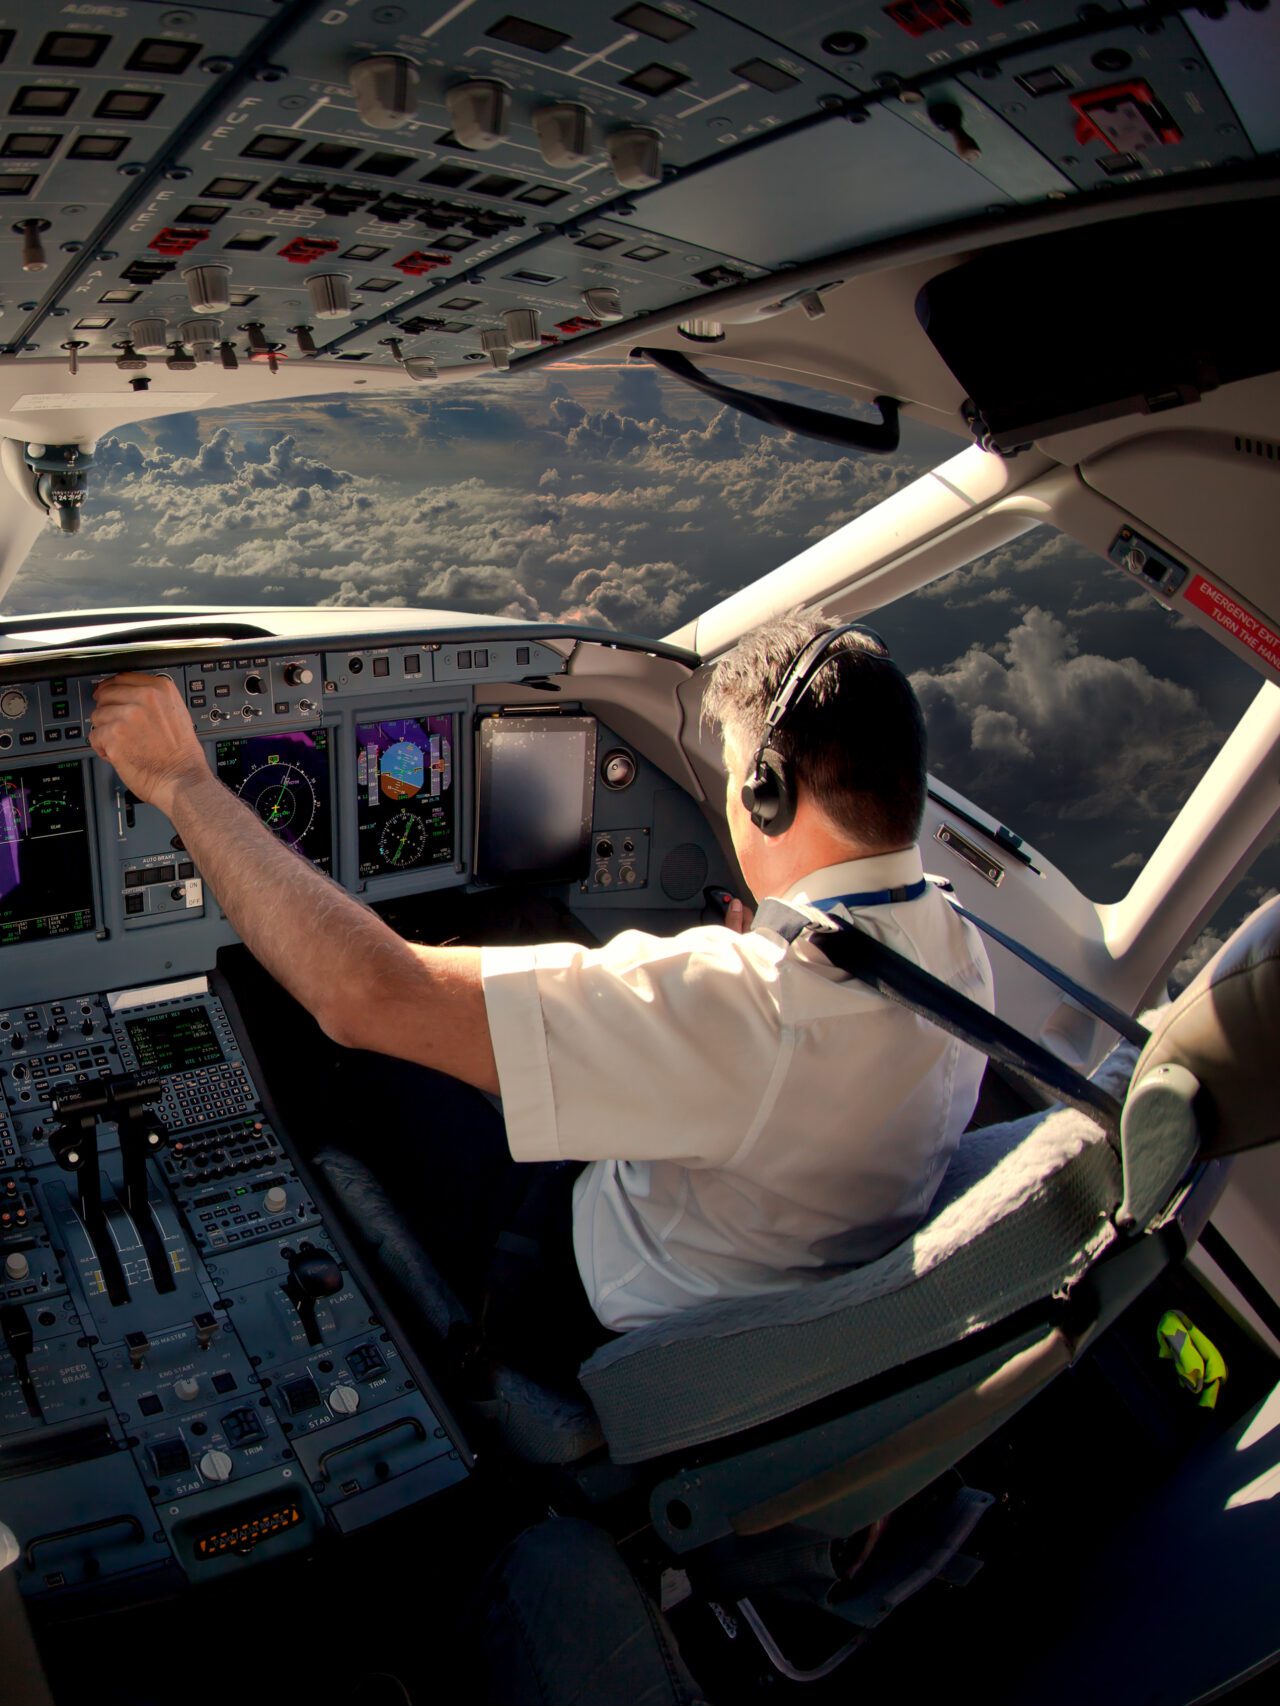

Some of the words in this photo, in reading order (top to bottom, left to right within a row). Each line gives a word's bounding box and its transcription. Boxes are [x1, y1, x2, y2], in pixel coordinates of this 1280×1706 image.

[200, 96, 264, 152] FUEL
[129, 191, 175, 232] ELEC
[75, 270, 103, 292] AIR
[1200, 582, 1259, 630] EMERGENCY
[1258, 628, 1279, 648] EXIT
[1212, 608, 1239, 632] TURN
[1240, 628, 1259, 648] THE
[329, 1292, 354, 1305] FLAPS
[162, 1333, 186, 1345] MASTER
[59, 1363, 87, 1376] SPEED
[159, 1370, 172, 1378] ENG
[173, 1363, 195, 1375] START
[62, 1372, 91, 1384] BRAKE
[368, 1378, 387, 1389] TRIM
[308, 1415, 330, 1429] STAB
[243, 1445, 264, 1456] TRIM
[176, 1481, 201, 1494] STAB
